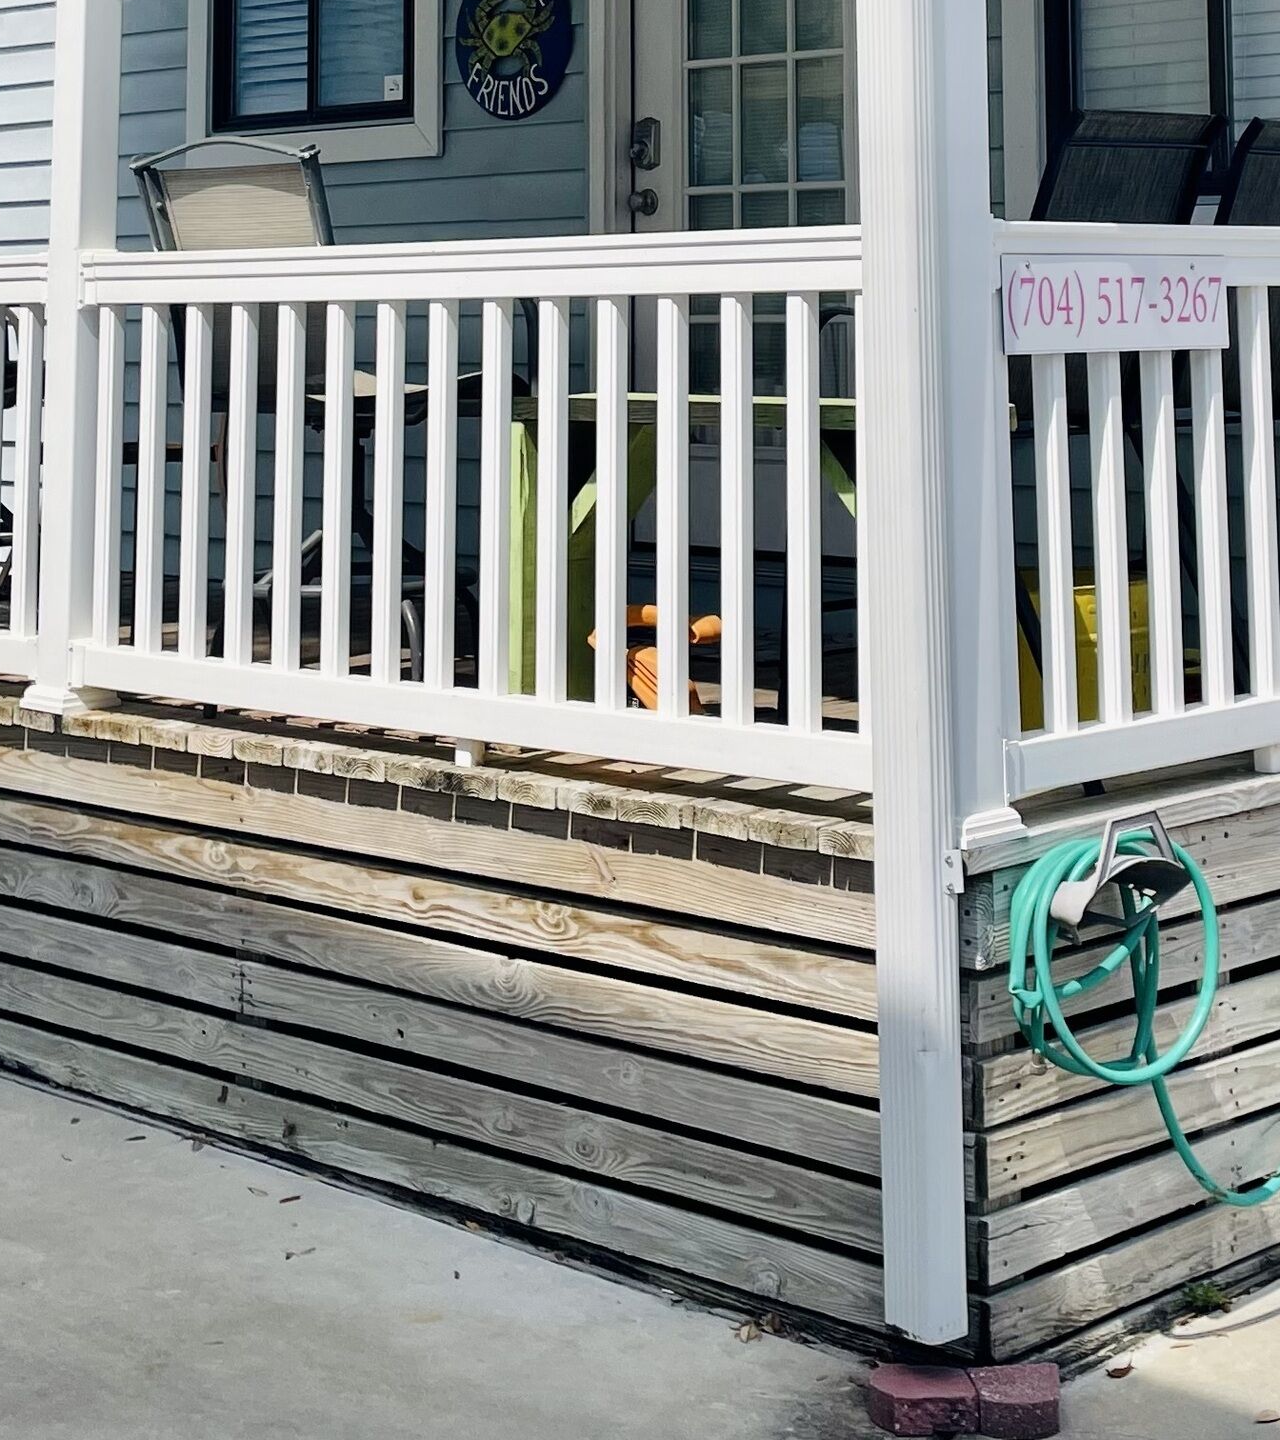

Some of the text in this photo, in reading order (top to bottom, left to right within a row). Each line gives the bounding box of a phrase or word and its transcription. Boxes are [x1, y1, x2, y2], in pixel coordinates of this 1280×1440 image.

[467, 62, 549, 116] FRIENDS
[1008, 269, 1222, 340] (704) 517-3267
